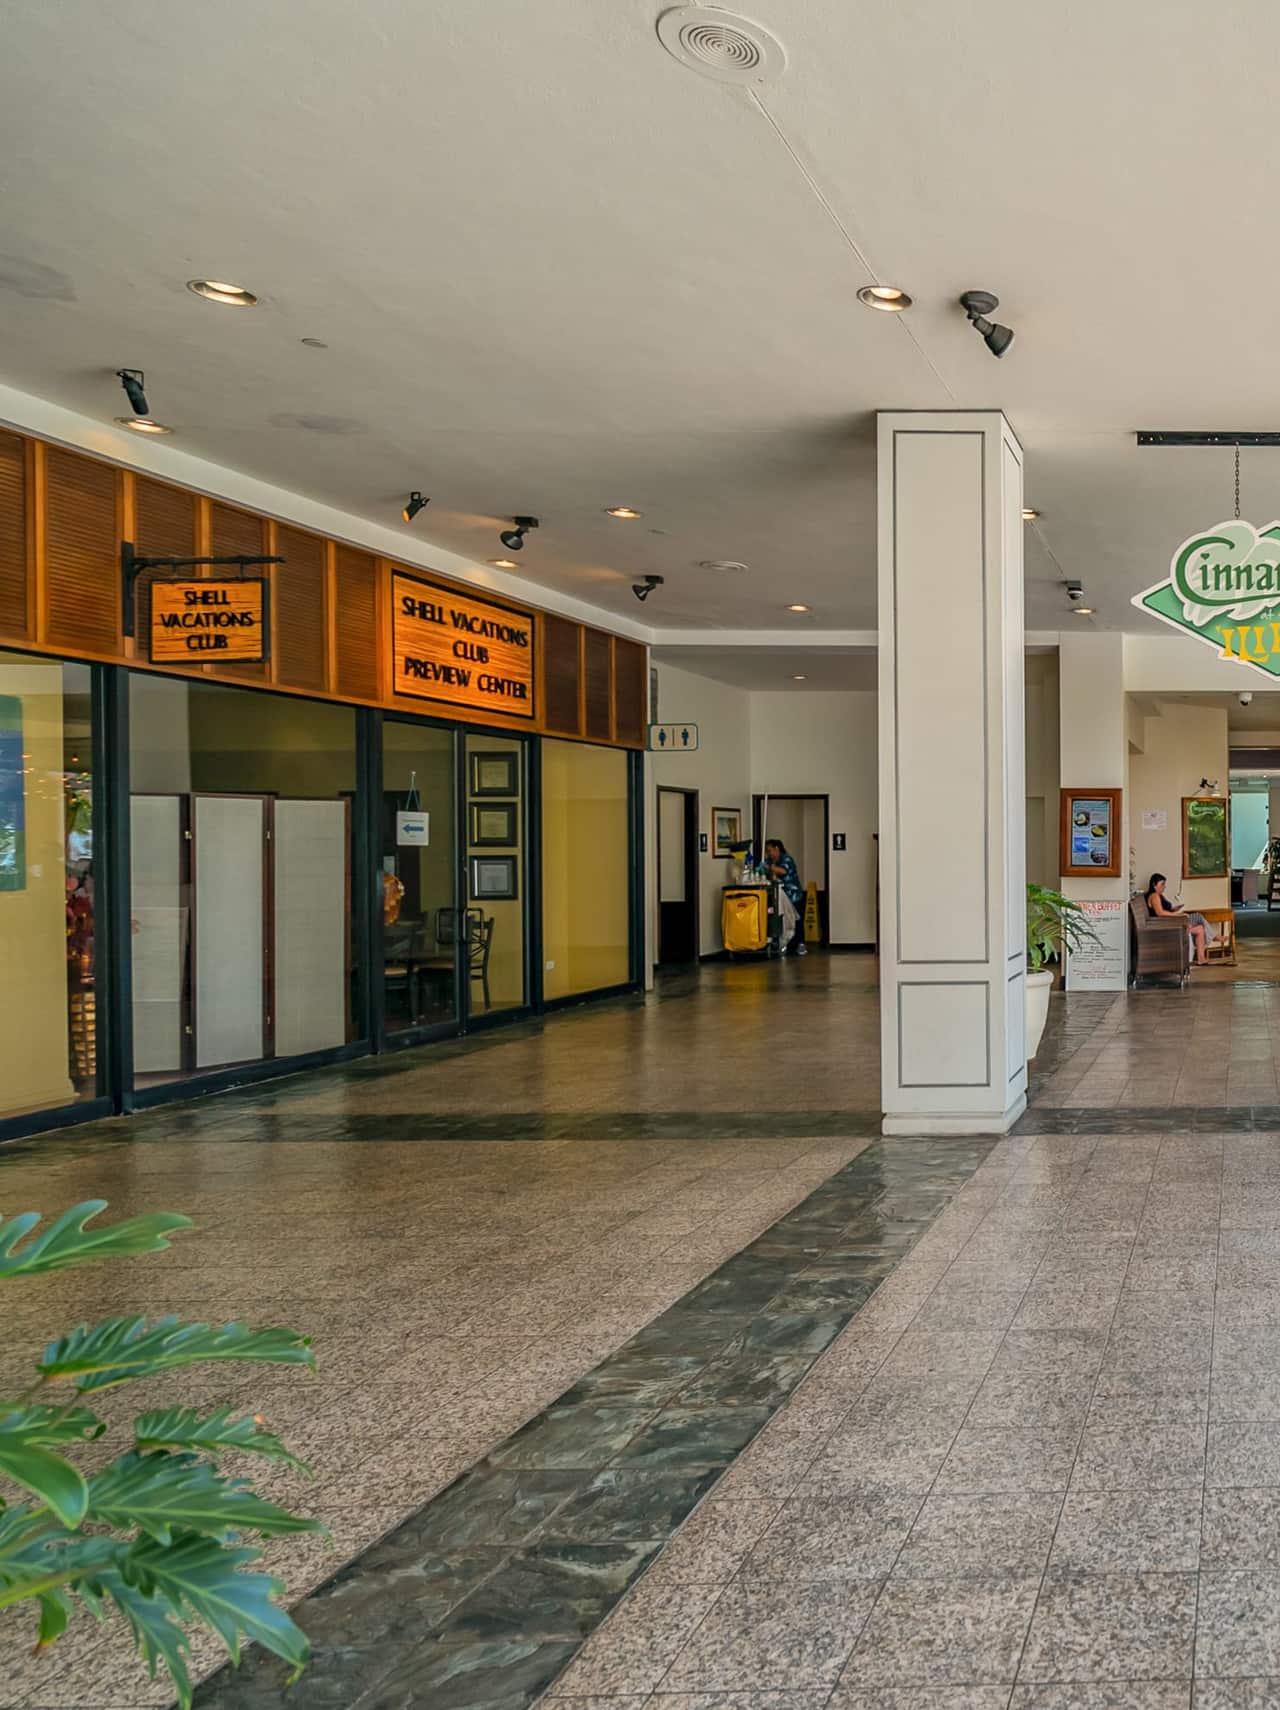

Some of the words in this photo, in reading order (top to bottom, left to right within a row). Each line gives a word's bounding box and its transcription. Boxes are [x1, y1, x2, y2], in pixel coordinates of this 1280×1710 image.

[184, 590, 231, 606] SHELL
[160, 612, 254, 628] VACATIONS
[402, 596, 447, 625] SHELL
[450, 609, 528, 648] VACATIONS
[1260, 608, 1275, 620] at
[186, 634, 228, 650] CLUB
[452, 640, 490, 664] CLUB
[404, 656, 472, 688] PREVIEW
[477, 673, 528, 699] CENTER
